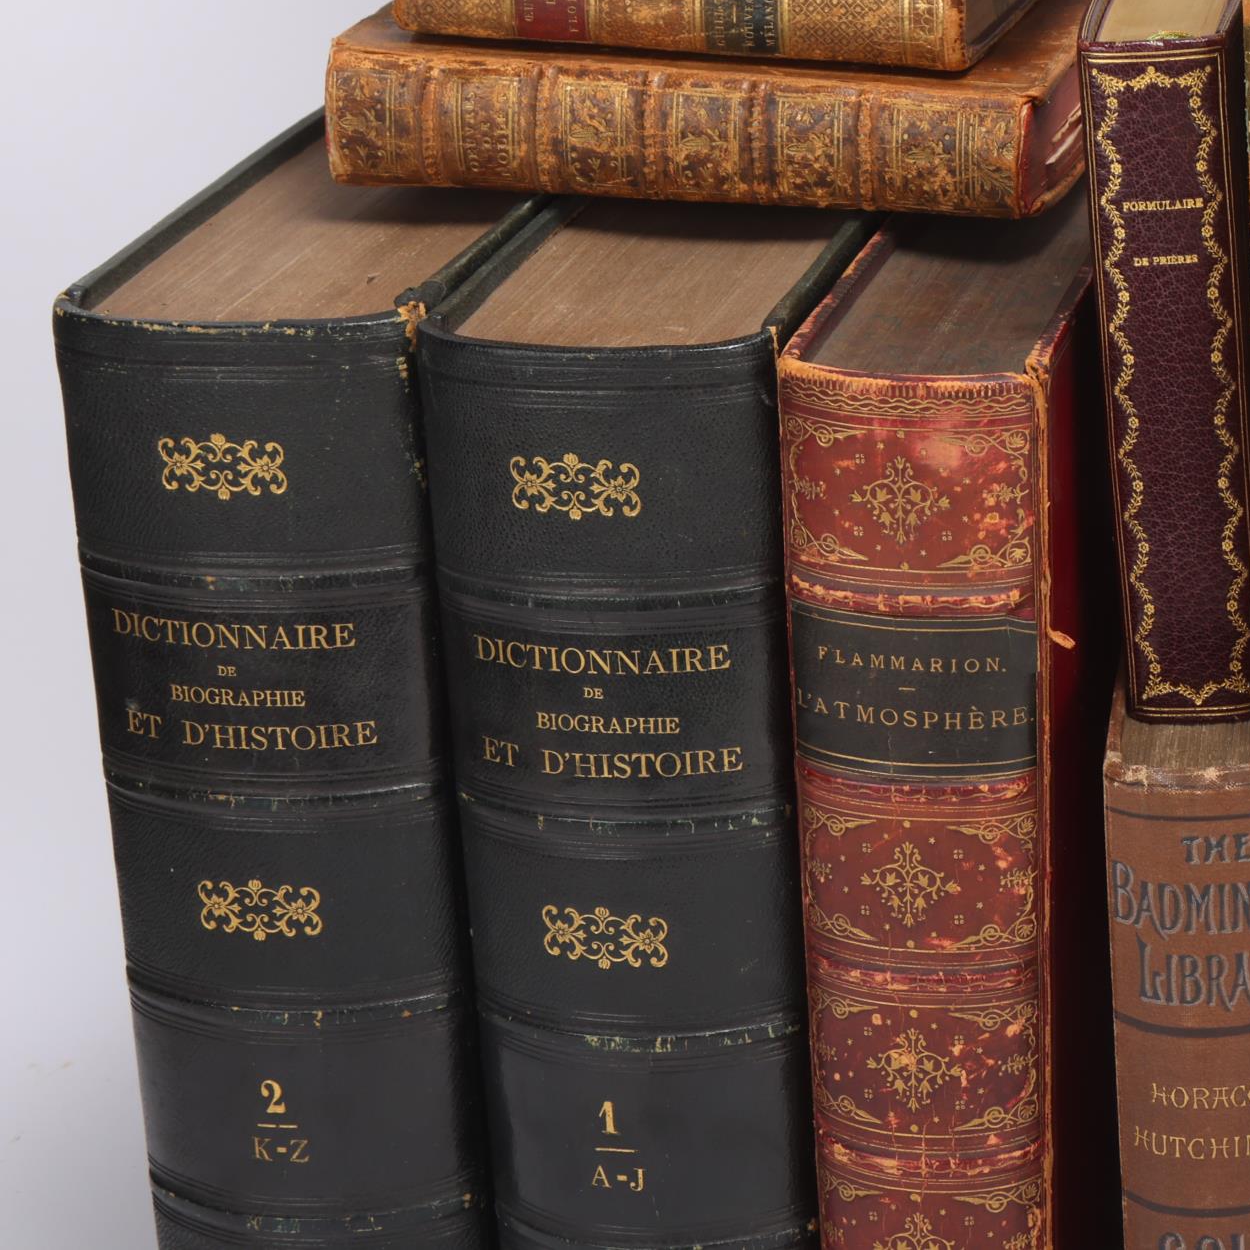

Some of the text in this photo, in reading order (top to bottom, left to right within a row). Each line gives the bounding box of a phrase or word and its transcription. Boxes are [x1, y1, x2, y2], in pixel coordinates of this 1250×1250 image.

[1122, 197, 1204, 212] FORMULAIRE
[1133, 257, 1150, 267] DE
[111, 608, 356, 650] DICTIONNAIRE
[473, 634, 732, 675] DICTIONNAIRE
[217, 665, 237, 677] DE
[170, 684, 306, 707] BIOGRAPHIE
[583, 687, 604, 700] DE
[127, 709, 379, 750] ET D'HISTOIRE
[536, 711, 680, 735] BIOGRAPHIE
[482, 736, 743, 779] ET D'HISTOIRE
[260, 1079, 287, 1114] 2
[599, 1100, 621, 1135] 1
[252, 1136, 310, 1163] K-Z
[591, 1165, 647, 1192] A-J
